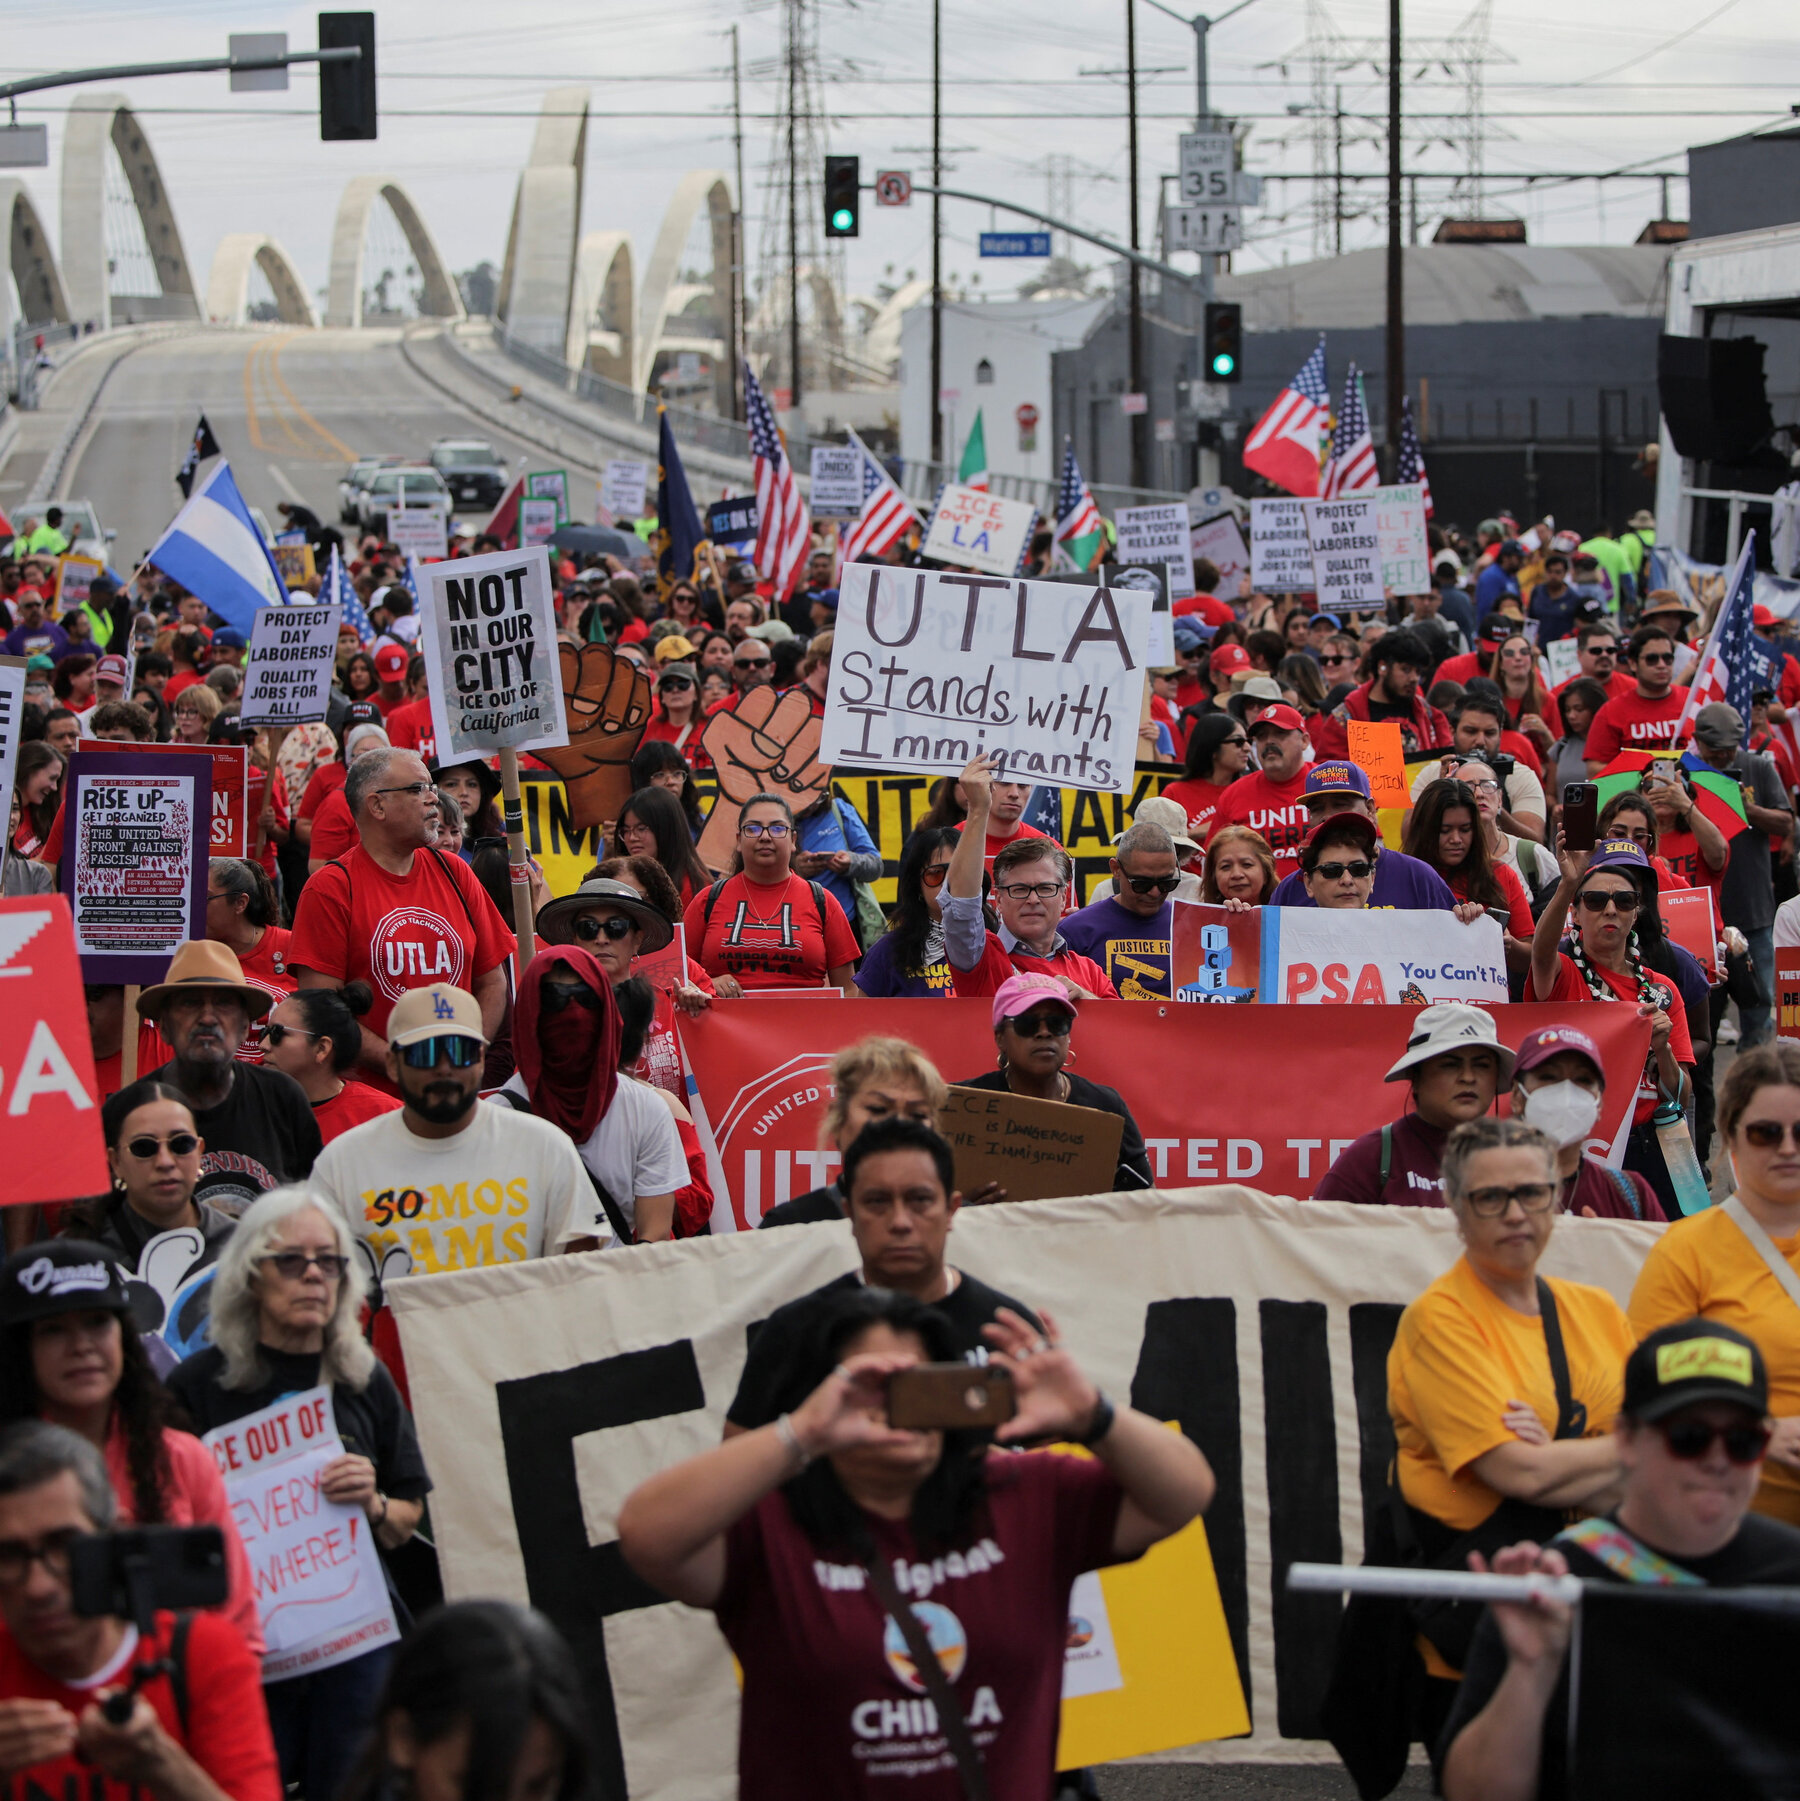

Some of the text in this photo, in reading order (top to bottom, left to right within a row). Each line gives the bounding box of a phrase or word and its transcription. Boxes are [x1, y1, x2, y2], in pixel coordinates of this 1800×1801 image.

[1184, 138, 1226, 150] SPEED
[1186, 154, 1224, 166] LIMIT
[1186, 171, 1227, 196] 35
[955, 494, 1004, 518] ICE
[1316, 504, 1368, 518] PROTECT
[712, 512, 730, 533] YES
[730, 510, 748, 530] ON
[939, 510, 1004, 532] OUT OF
[1126, 508, 1176, 522] PROTECT
[1276, 516, 1298, 527] DAY
[1119, 526, 1142, 536] OUR
[1332, 521, 1356, 534] DAY
[952, 525, 989, 552] LA
[1128, 534, 1180, 548] RELEASE
[1313, 536, 1378, 552] LABORERS!
[1265, 548, 1310, 559] QUALITY
[1260, 562, 1287, 572] JOBS
[1326, 558, 1370, 571] QUALITY
[1276, 574, 1300, 583] ALL!
[1324, 572, 1374, 587] JOBS FOR
[446, 566, 528, 622] NOT
[1340, 588, 1364, 600] ALL!
[264, 610, 331, 627] PROTECT
[866, 569, 1136, 671] UTLA
[280, 628, 311, 644] DAY
[450, 613, 534, 651] IN OUR
[250, 644, 334, 662] LABORERS!
[454, 641, 536, 694] CITY
[260, 669, 318, 684] QUALITY
[250, 685, 318, 700] JOBS FOR
[460, 682, 538, 710] ICE OUT OF
[839, 651, 1112, 742] Stands with
[268, 702, 300, 715] ALL!
[460, 704, 540, 734] California
[1310, 766, 1348, 778] education
[1316, 772, 1349, 780] workers
[82, 812, 103, 822] GET
[92, 829, 160, 840] THE UNITED
[91, 842, 180, 853] FRONT AGAINST
[90, 855, 139, 865] FASCISM
[1668, 897, 1684, 905] UTLA
[386, 918, 408, 938] UNITED
[1112, 942, 1156, 953] JUSTICE
[385, 940, 452, 976] UTLA
[718, 952, 804, 964] HARBOR AREA
[726, 960, 793, 975] UTLA
[1400, 962, 1488, 982] You Can't
[395, 983, 410, 994] LO
[1286, 962, 1389, 1004] PSA
[432, 992, 454, 1020] LA
[752, 1086, 820, 1136] UNITED
[938, 1093, 1000, 1114] ICE
[246, 1412, 292, 1463] OUT
[298, 1398, 326, 1440] OF
[229, 1469, 323, 1543] EVERY
[253, 1517, 358, 1600] WHERE!
[301, 1650, 322, 1667] OUR
